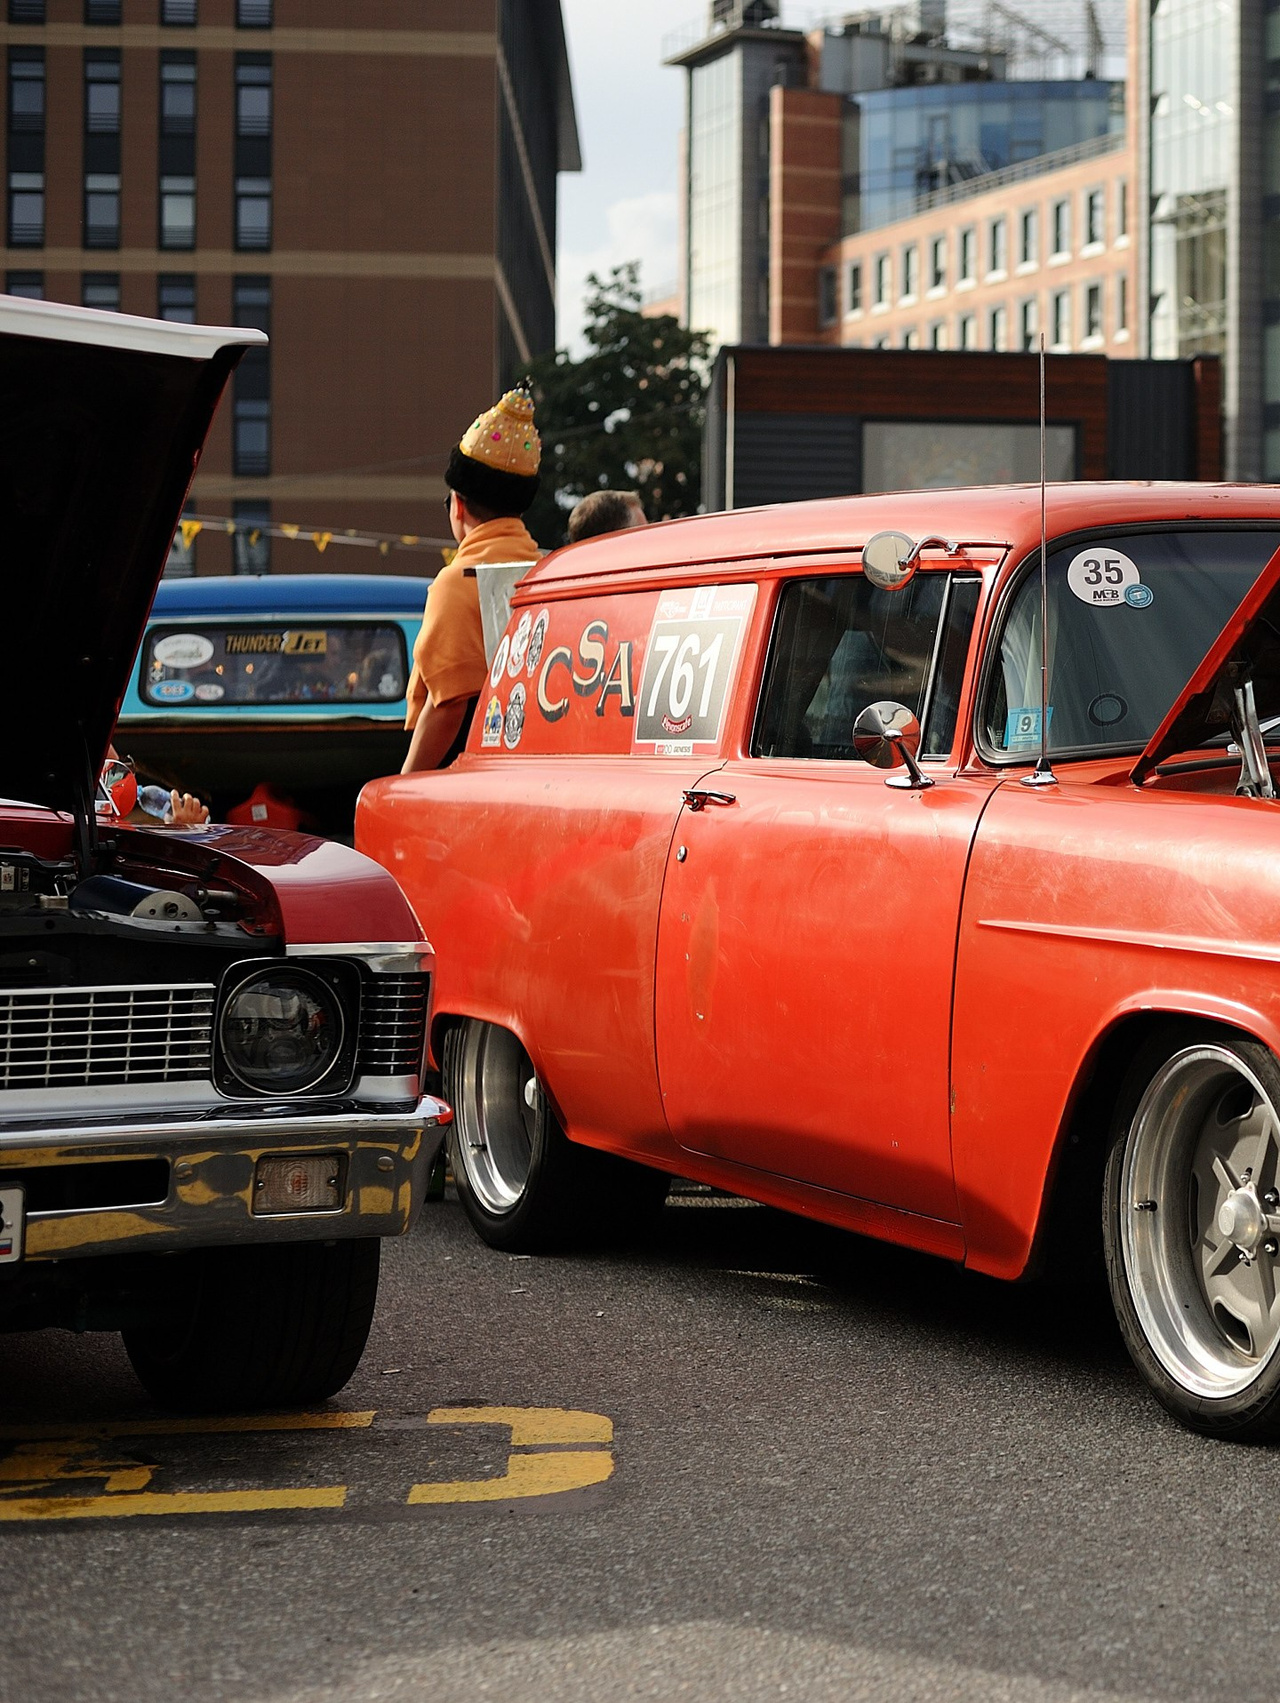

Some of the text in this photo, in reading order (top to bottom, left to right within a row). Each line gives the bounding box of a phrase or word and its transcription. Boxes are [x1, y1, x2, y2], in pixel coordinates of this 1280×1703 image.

[1083, 559, 1124, 585] 35
[226, 633, 282, 654] THUNDER
[647, 633, 724, 719] 761
[1020, 716, 1032, 733] 9
